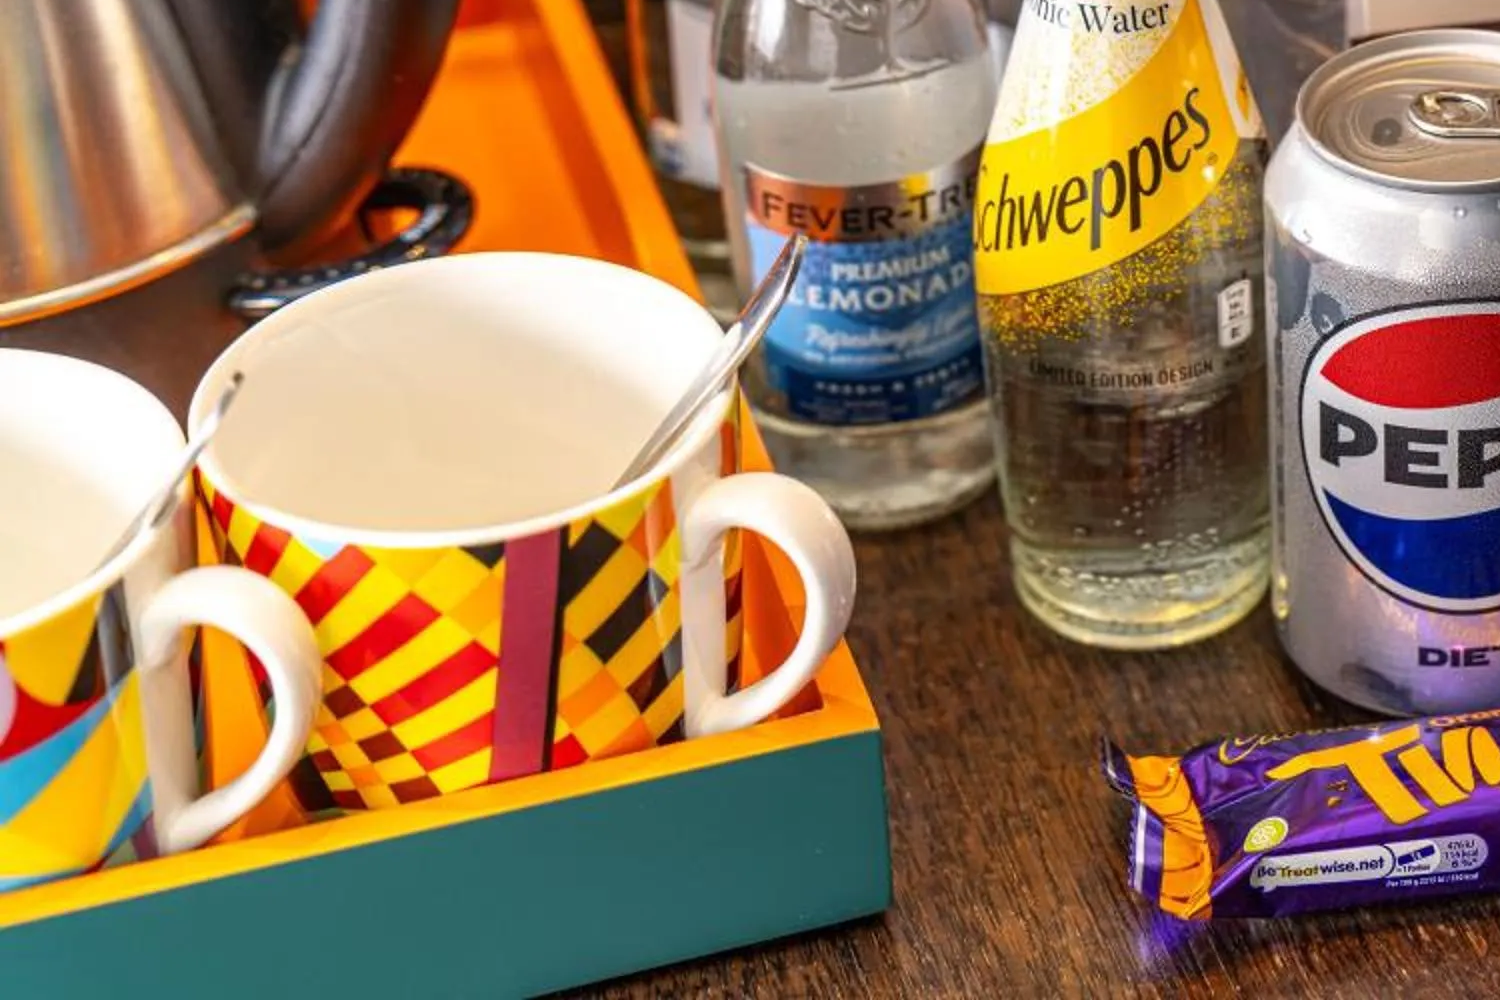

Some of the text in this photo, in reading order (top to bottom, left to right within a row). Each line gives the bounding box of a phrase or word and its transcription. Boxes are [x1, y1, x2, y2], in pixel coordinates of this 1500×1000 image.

[1077, 2, 1170, 35] Water
[830, 247, 950, 282] PREMIUM
[1029, 358, 1086, 386] LIMITED
[1090, 371, 1153, 388] EDITION
[1157, 358, 1214, 385] DESIGN
